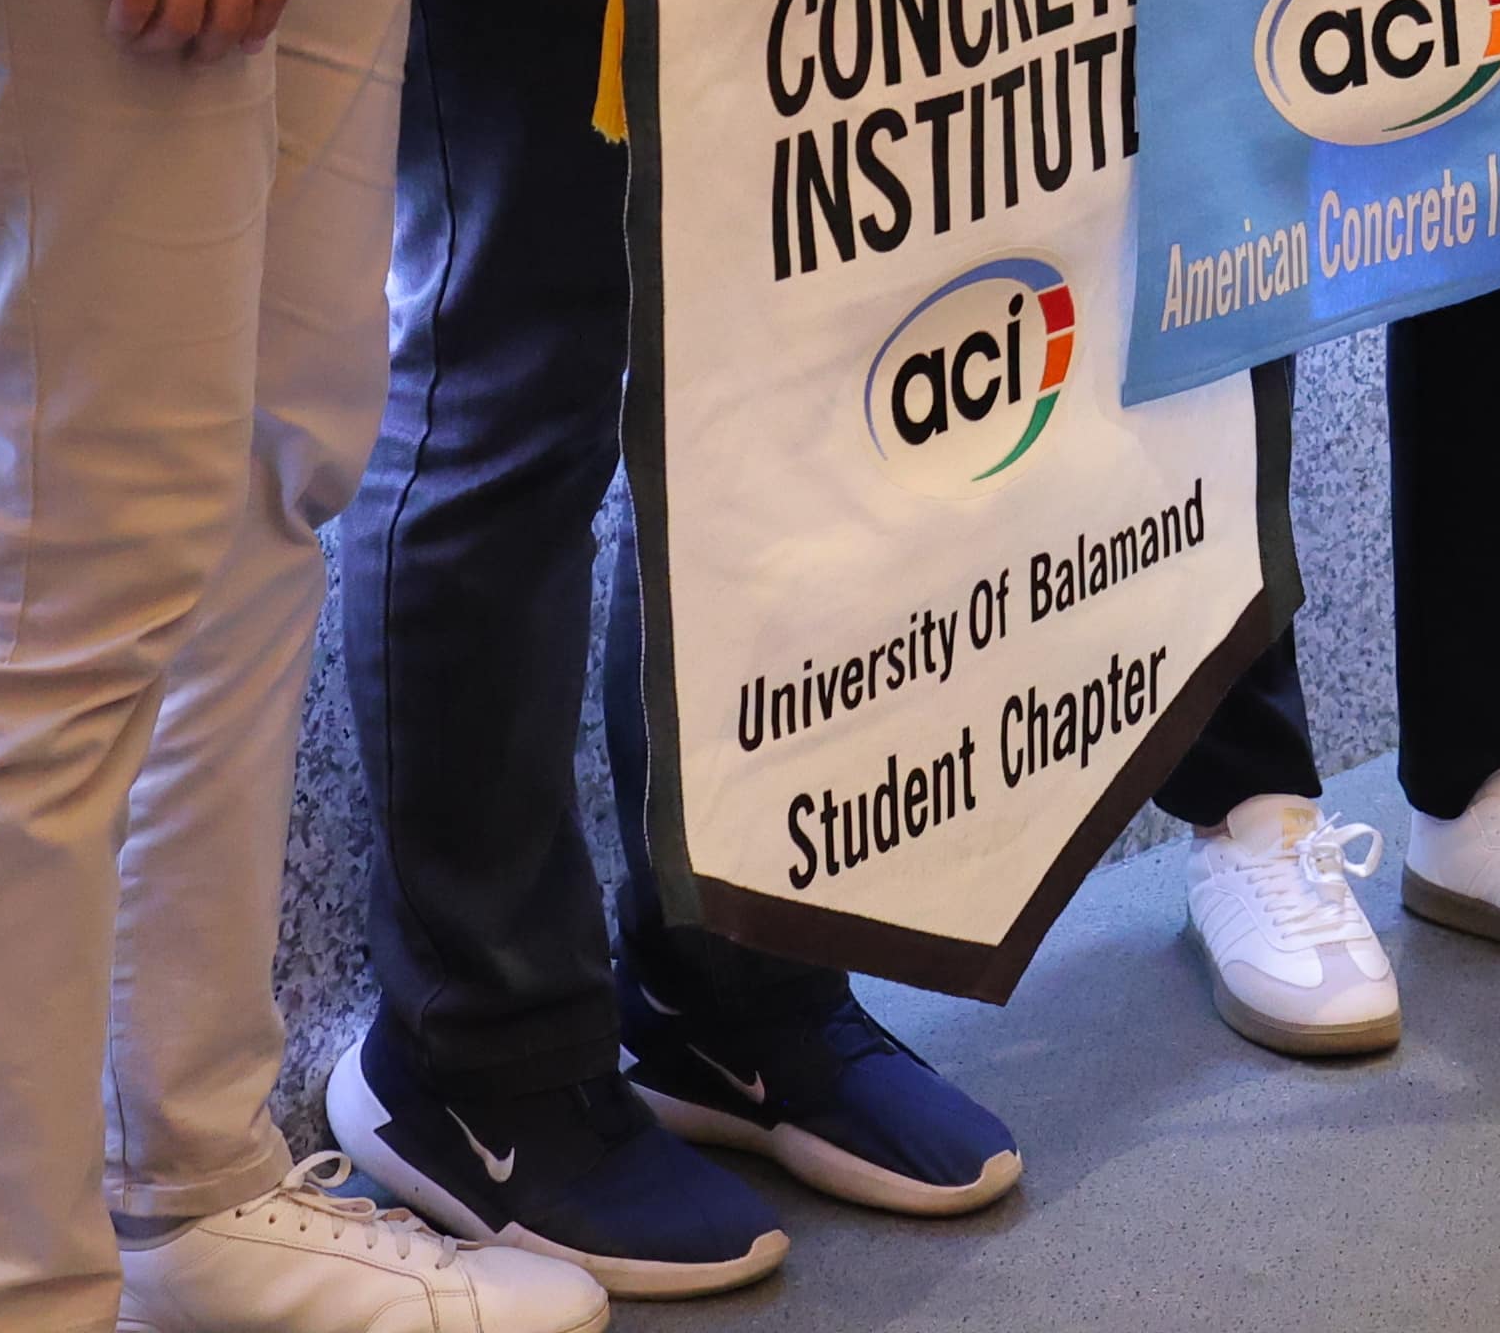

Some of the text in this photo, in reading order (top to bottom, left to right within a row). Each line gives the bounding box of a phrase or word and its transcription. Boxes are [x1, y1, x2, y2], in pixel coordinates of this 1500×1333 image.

[1161, 218, 1309, 332] American
[1318, 168, 1477, 278] Concrete
[891, 292, 1024, 445] aci
[737, 478, 1206, 753] University Of Balamand
[787, 645, 1167, 890] Student Chapter
